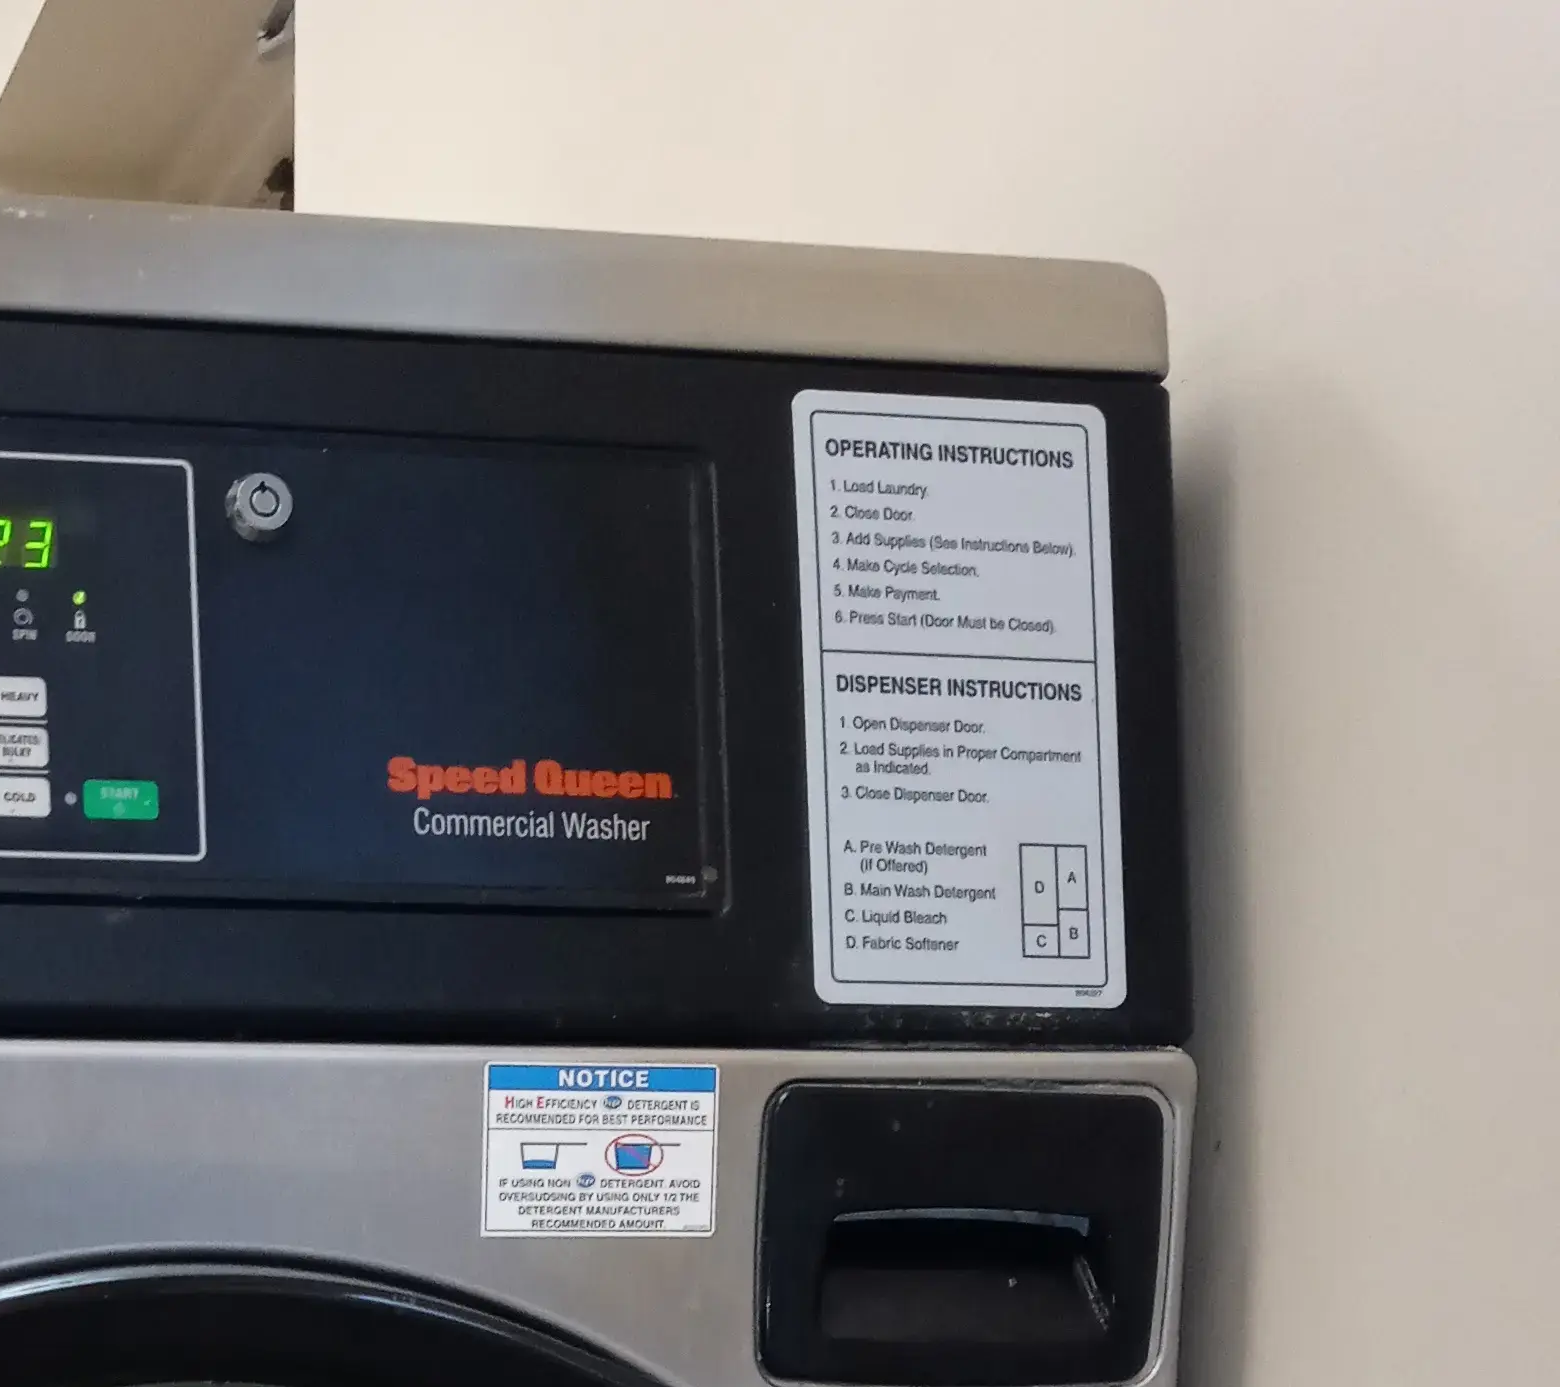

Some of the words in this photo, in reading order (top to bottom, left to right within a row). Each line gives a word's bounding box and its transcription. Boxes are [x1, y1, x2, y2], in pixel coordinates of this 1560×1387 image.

[826, 439, 932, 460] OPERATING
[939, 445, 1073, 468] INSTRUCTIONS
[844, 480, 873, 493] Load
[845, 506, 879, 519] Close
[846, 532, 870, 545] Add
[874, 534, 926, 549] Supplies
[930, 535, 957, 550] (See
[962, 538, 1028, 553] Instructions
[848, 559, 880, 572] Make
[884, 559, 917, 575] Cycle
[849, 585, 881, 598] Make
[850, 611, 884, 624] Press
[888, 613, 917, 626] Start
[921, 613, 953, 628] (Door
[958, 615, 986, 629] Must
[991, 617, 1004, 630] be
[836, 674, 941, 696] DISPENSER
[948, 679, 1081, 701] INSTRUCTIONS
[1, 691, 39, 701] HEAVY
[853, 717, 886, 732] Open
[890, 718, 950, 734] Dispenser
[855, 743, 884, 755] Load
[889, 744, 939, 759] Supplies
[943, 745, 953, 757] in
[958, 746, 997, 762] Proper
[1001, 747, 1081, 764] Compartment
[856, 762, 869, 773] as
[387, 756, 526, 800] Speed
[534, 759, 672, 799] Queen
[4, 792, 36, 803] COLD
[100, 788, 139, 800] START
[856, 787, 889, 800] Close
[895, 787, 954, 803] Dispenser
[413, 806, 554, 838] Commercial
[561, 811, 650, 841] Washer
[844, 840, 857, 853] A.
[860, 841, 882, 854] Pre
[886, 842, 921, 855] Wash
[926, 843, 987, 859] Detergent
[877, 859, 928, 875] Offered)
[1067, 871, 1076, 884] A
[861, 884, 890, 896] Main
[895, 884, 930, 898] Wash
[935, 885, 996, 902] Detergent
[1035, 881, 1045, 894] D
[862, 910, 899, 925] Liquid
[904, 911, 947, 925] Bleach
[1069, 927, 1079, 940] B
[863, 936, 901, 950] Fabric
[906, 938, 959, 951] Softener
[1036, 935, 1047, 948] C
[558, 1069, 649, 1088] NOTICE
[627, 1100, 687, 1110] DETERGENT
[691, 1100, 700, 1110] IS
[496, 1114, 575, 1124] RECOMMENDED
[579, 1114, 599, 1124] FOR
[602, 1114, 628, 1125] BEST
[631, 1115, 707, 1126] PERFORMANCE
[499, 1179, 508, 1188] IF
[512, 1179, 544, 1188] USING
[548, 1179, 571, 1188] NON
[669, 1180, 701, 1188] AVOID
[499, 1193, 575, 1201] OVERSUDSING
[579, 1193, 593, 1201] BY
[596, 1193, 629, 1201] USING
[632, 1193, 659, 1201] ONLY
[663, 1193, 676, 1201] 1/2
[680, 1193, 699, 1202] THE
[518, 1206, 583, 1215] DETERGENT
[586, 1206, 680, 1215] MANUFACTURERS
[531, 1219, 615, 1228] RECOMMENDED
